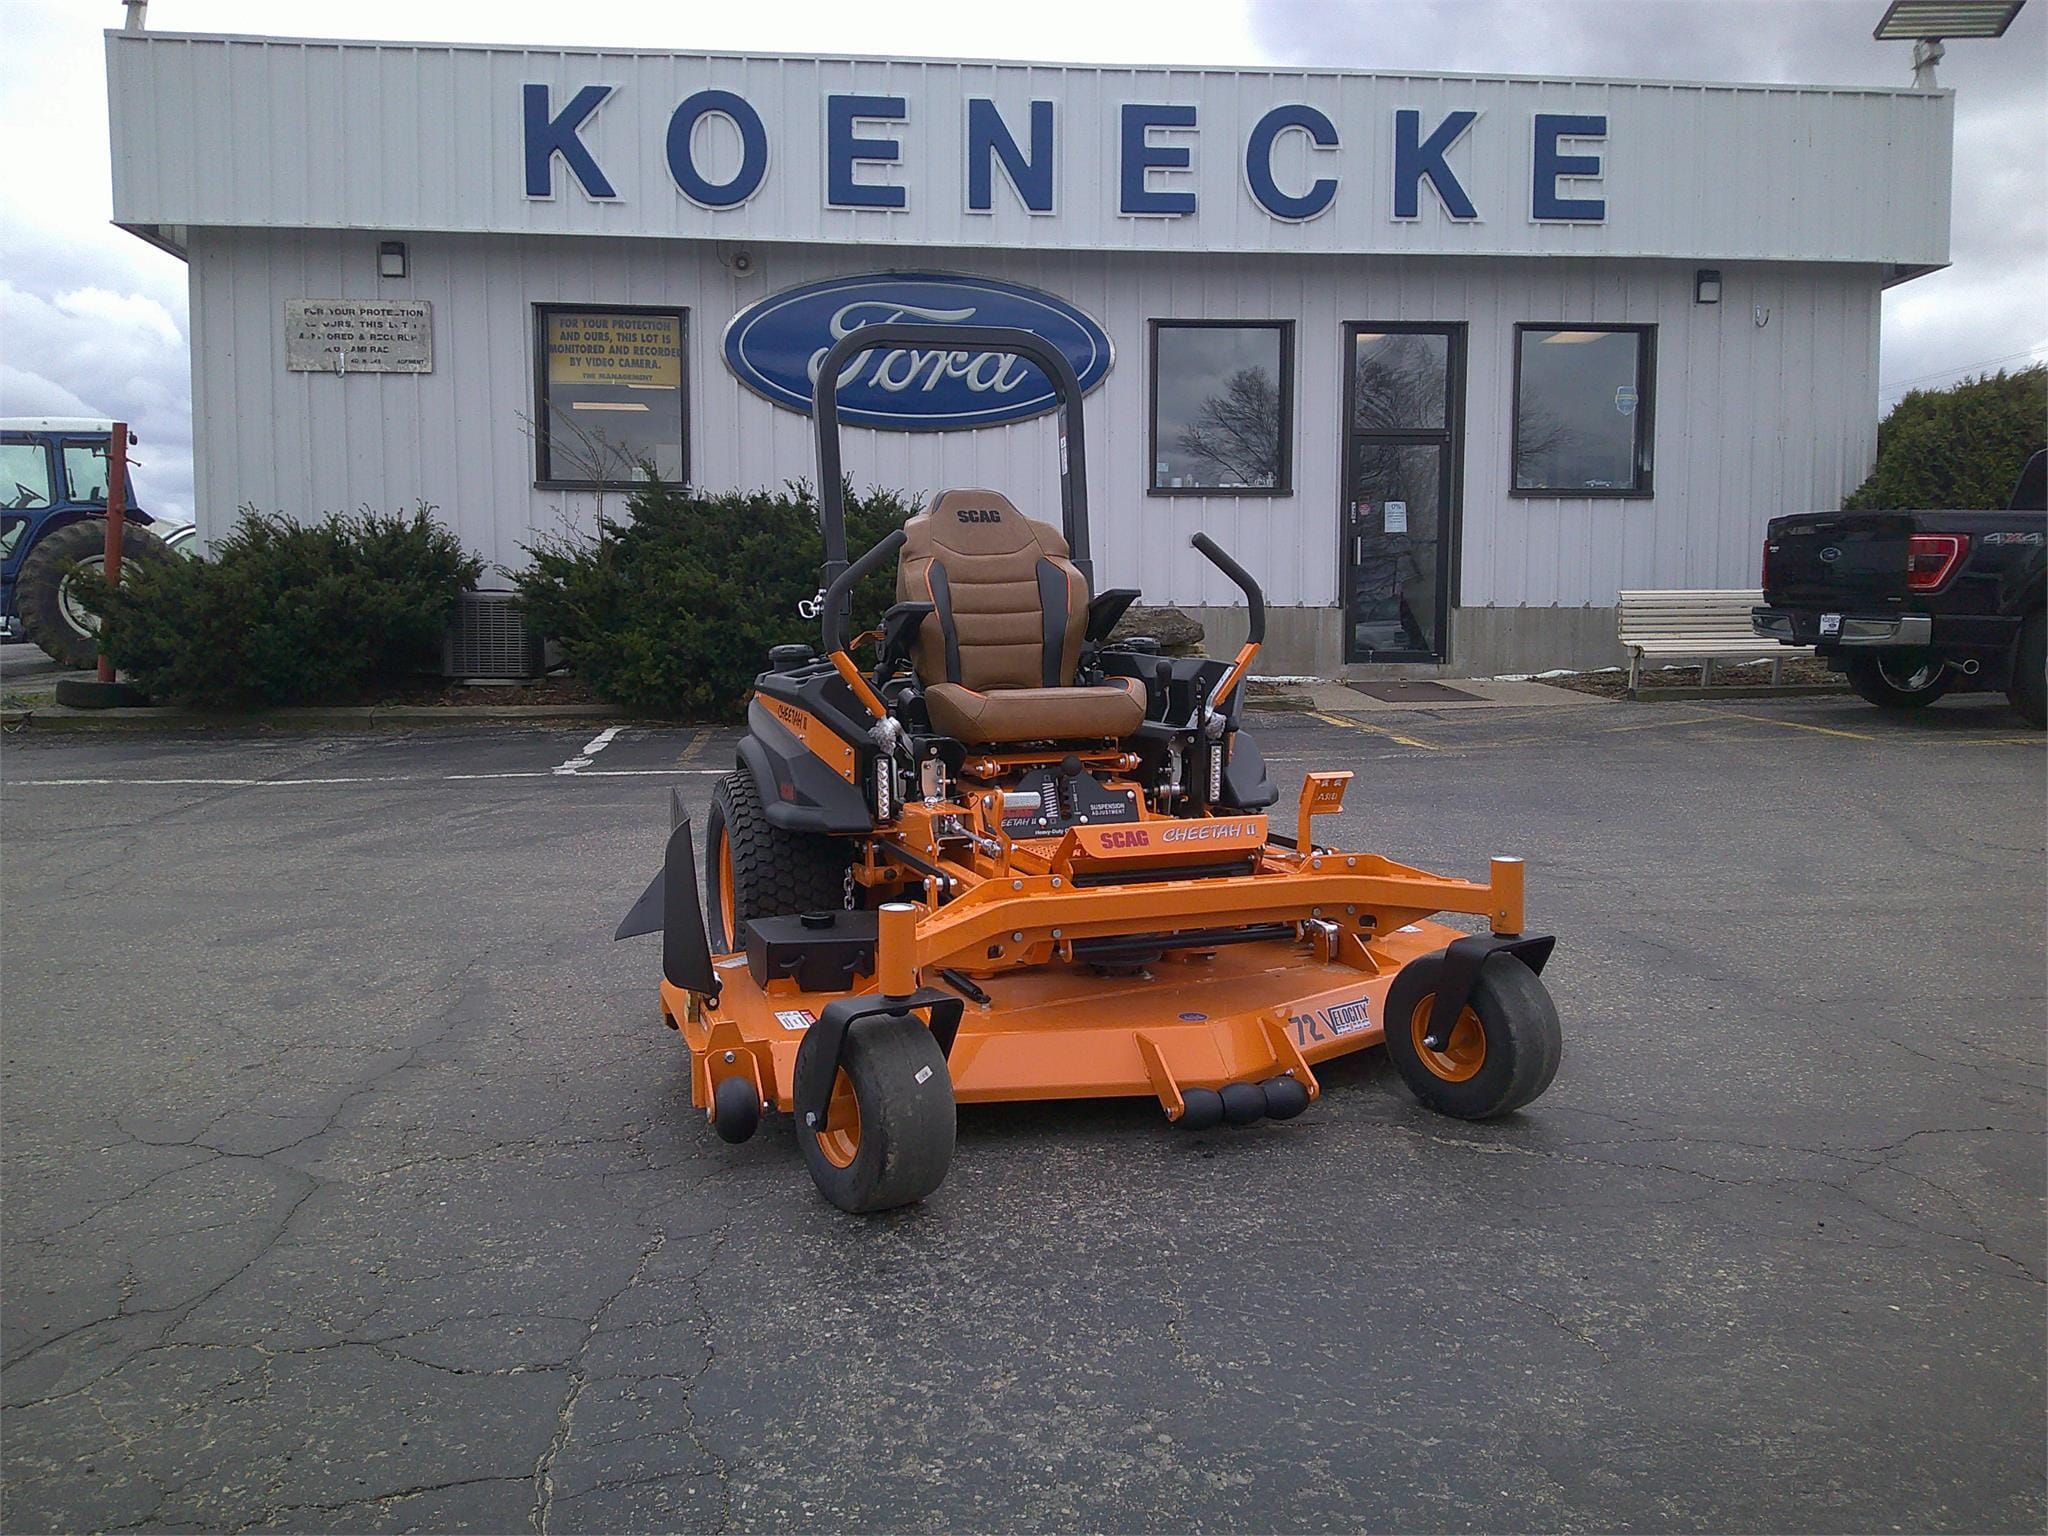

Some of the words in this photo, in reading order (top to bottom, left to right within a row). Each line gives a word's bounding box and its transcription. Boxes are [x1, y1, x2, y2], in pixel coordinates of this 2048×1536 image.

[524, 84, 1606, 220] KOENECKE
[360, 309, 423, 317] PROTETION
[360, 321, 383, 329] THIS
[389, 321, 408, 329] LT
[560, 319, 578, 329] FOR
[583, 319, 608, 329] YOUR
[612, 320, 671, 331] PROTECTION
[560, 331, 580, 341] AND
[584, 331, 612, 343] OURS,
[616, 332, 637, 343] THIS
[641, 334, 658, 344] LOT
[662, 334, 671, 344] IS
[549, 343, 605, 354] MONITORED
[609, 345, 630, 355] AND
[570, 357, 581, 367] BY
[586, 357, 614, 367] VIDEO
[618, 358, 661, 369] CAMERA.
[600, 373, 653, 381] MANAGEMENT
[957, 510, 1001, 523] SCAG
[778, 704, 803, 728] CHEETAH
[1090, 802, 1125, 810] SUSPENSION
[1100, 830, 1150, 849] SCAG
[1162, 823, 1242, 842] CHEETAH
[1288, 1013, 1325, 1046] 72
